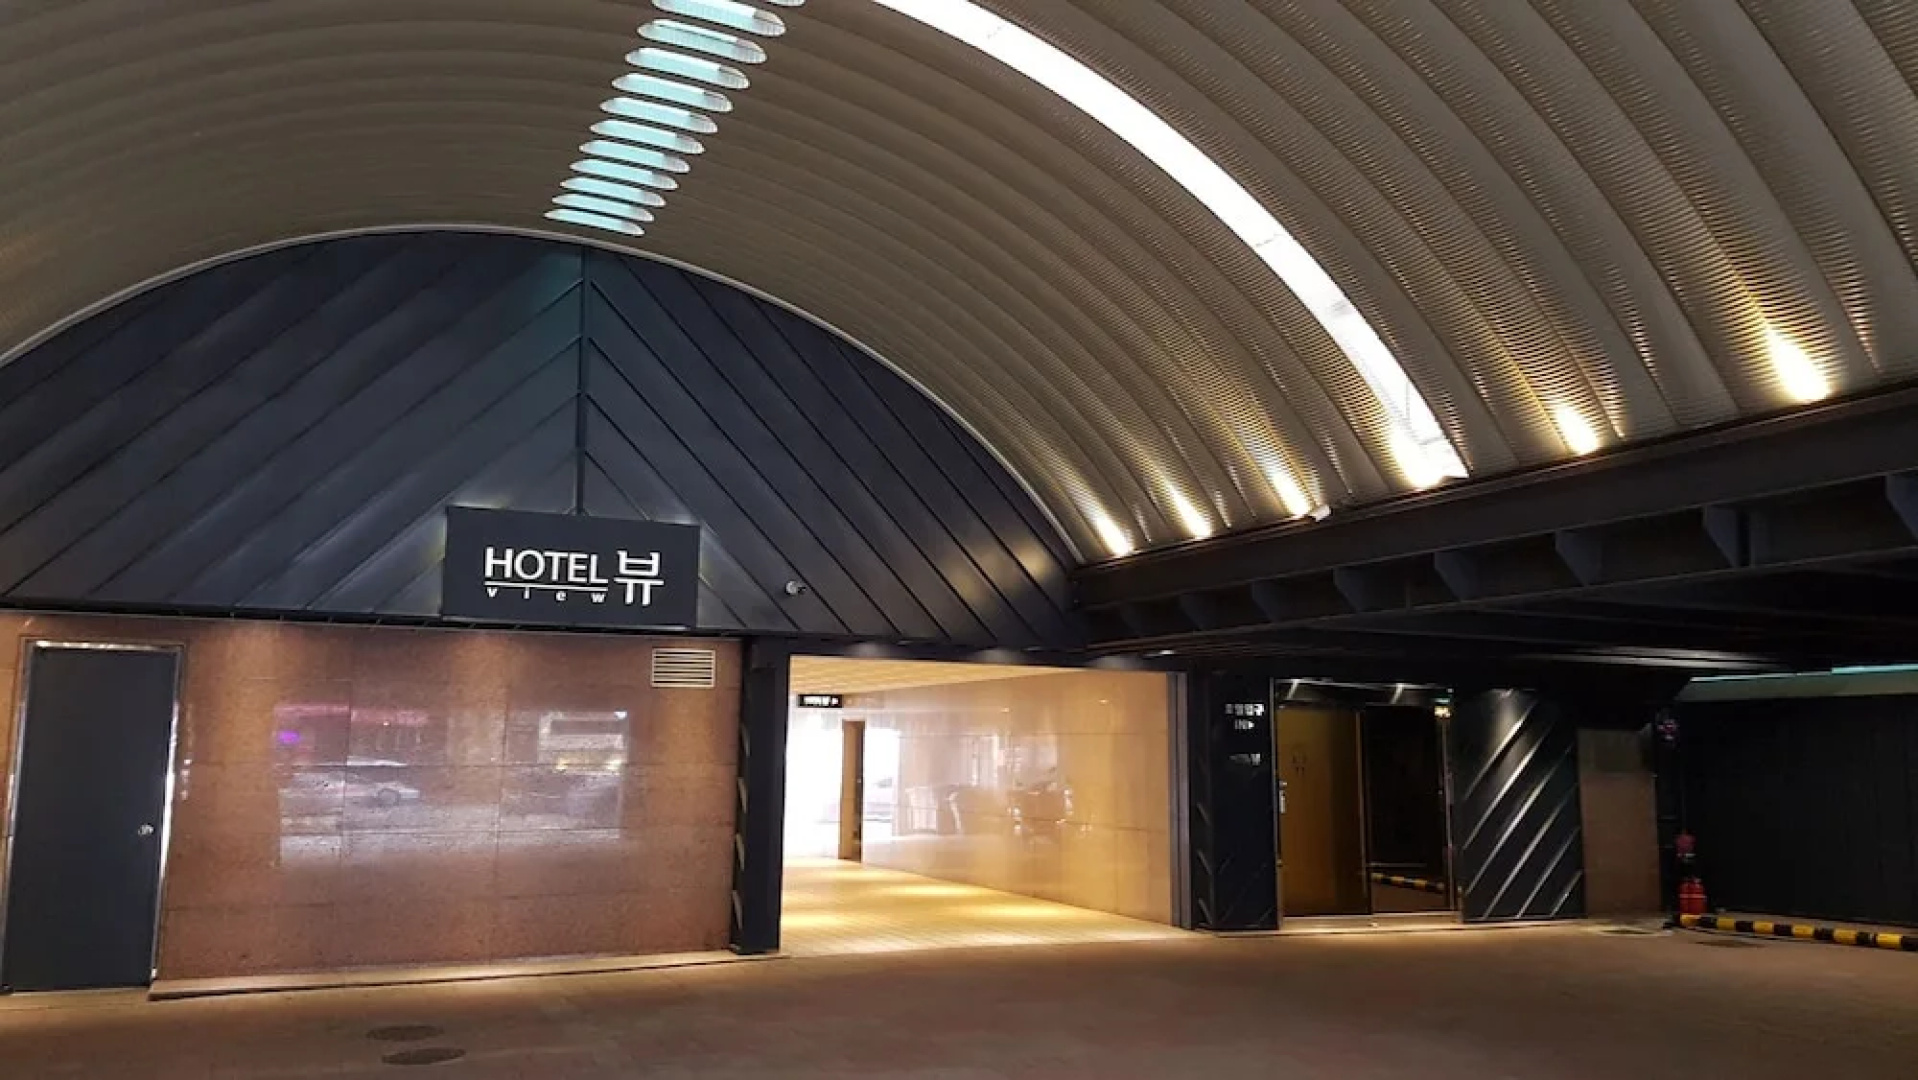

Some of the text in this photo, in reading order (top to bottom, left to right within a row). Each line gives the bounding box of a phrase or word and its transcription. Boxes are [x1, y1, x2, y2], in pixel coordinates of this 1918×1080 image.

[484, 546, 665, 606] HOTEL 뷰
[486, 586, 606, 603] view
